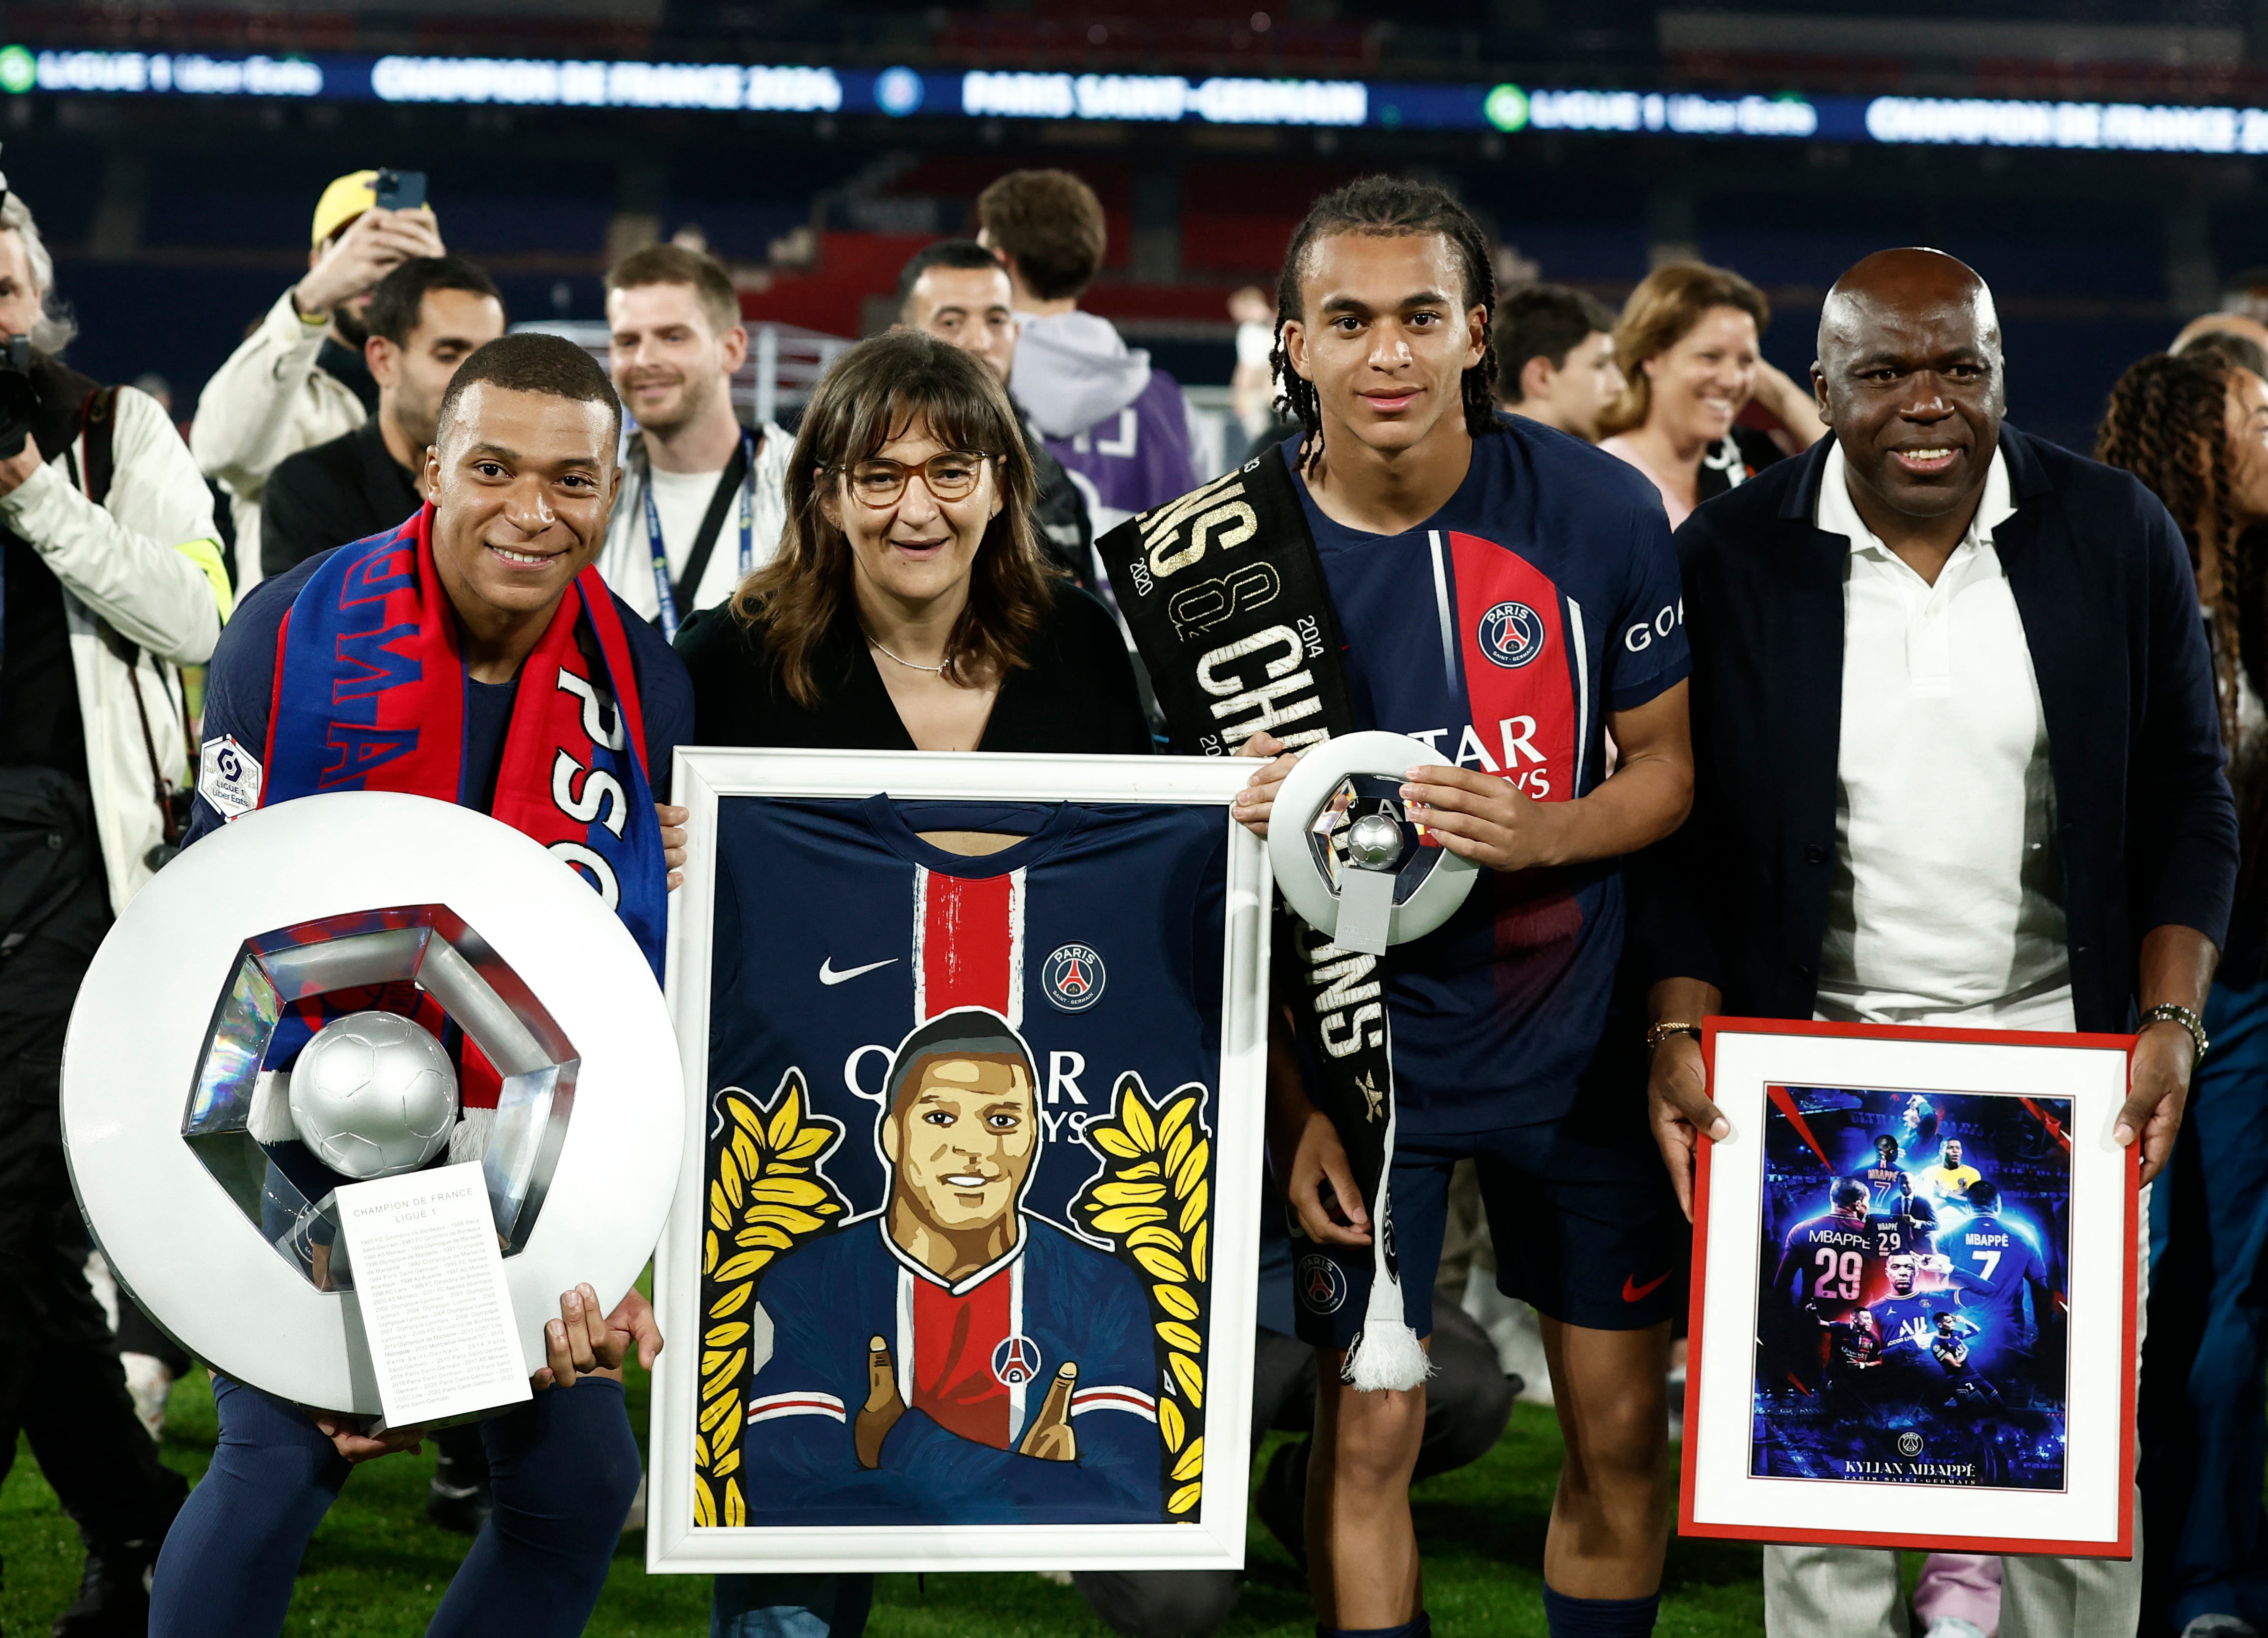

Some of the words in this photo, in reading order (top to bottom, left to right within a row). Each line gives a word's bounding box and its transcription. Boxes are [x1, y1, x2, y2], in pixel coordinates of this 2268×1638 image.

[1130, 557, 1153, 597] 2020
[1487, 605, 1529, 624] PARIS
[1297, 615, 1324, 659] 2014
[216, 780, 240, 794] LIGUE
[212, 788, 230, 800] Uber
[231, 794, 249, 807] Eats
[1053, 948, 1095, 964] PARIS
[353, 1200, 408, 1217] CHAMPION
[412, 1196, 426, 1206] DE
[431, 1188, 472, 1203] FRANCE
[1874, 1181, 1891, 1207] 7
[395, 1210, 427, 1223] LIGUE
[1809, 1229, 1871, 1250] MBAPPÉ
[1878, 1233, 1901, 1251] 29
[1965, 1233, 2009, 1247] MBAPPÉ
[1814, 1247, 1863, 1300] 29
[1972, 1250, 2002, 1281] 7
[1845, 1460, 1903, 1474] KYLIAN
[1909, 1463, 1976, 1477] MBAPPÉ
